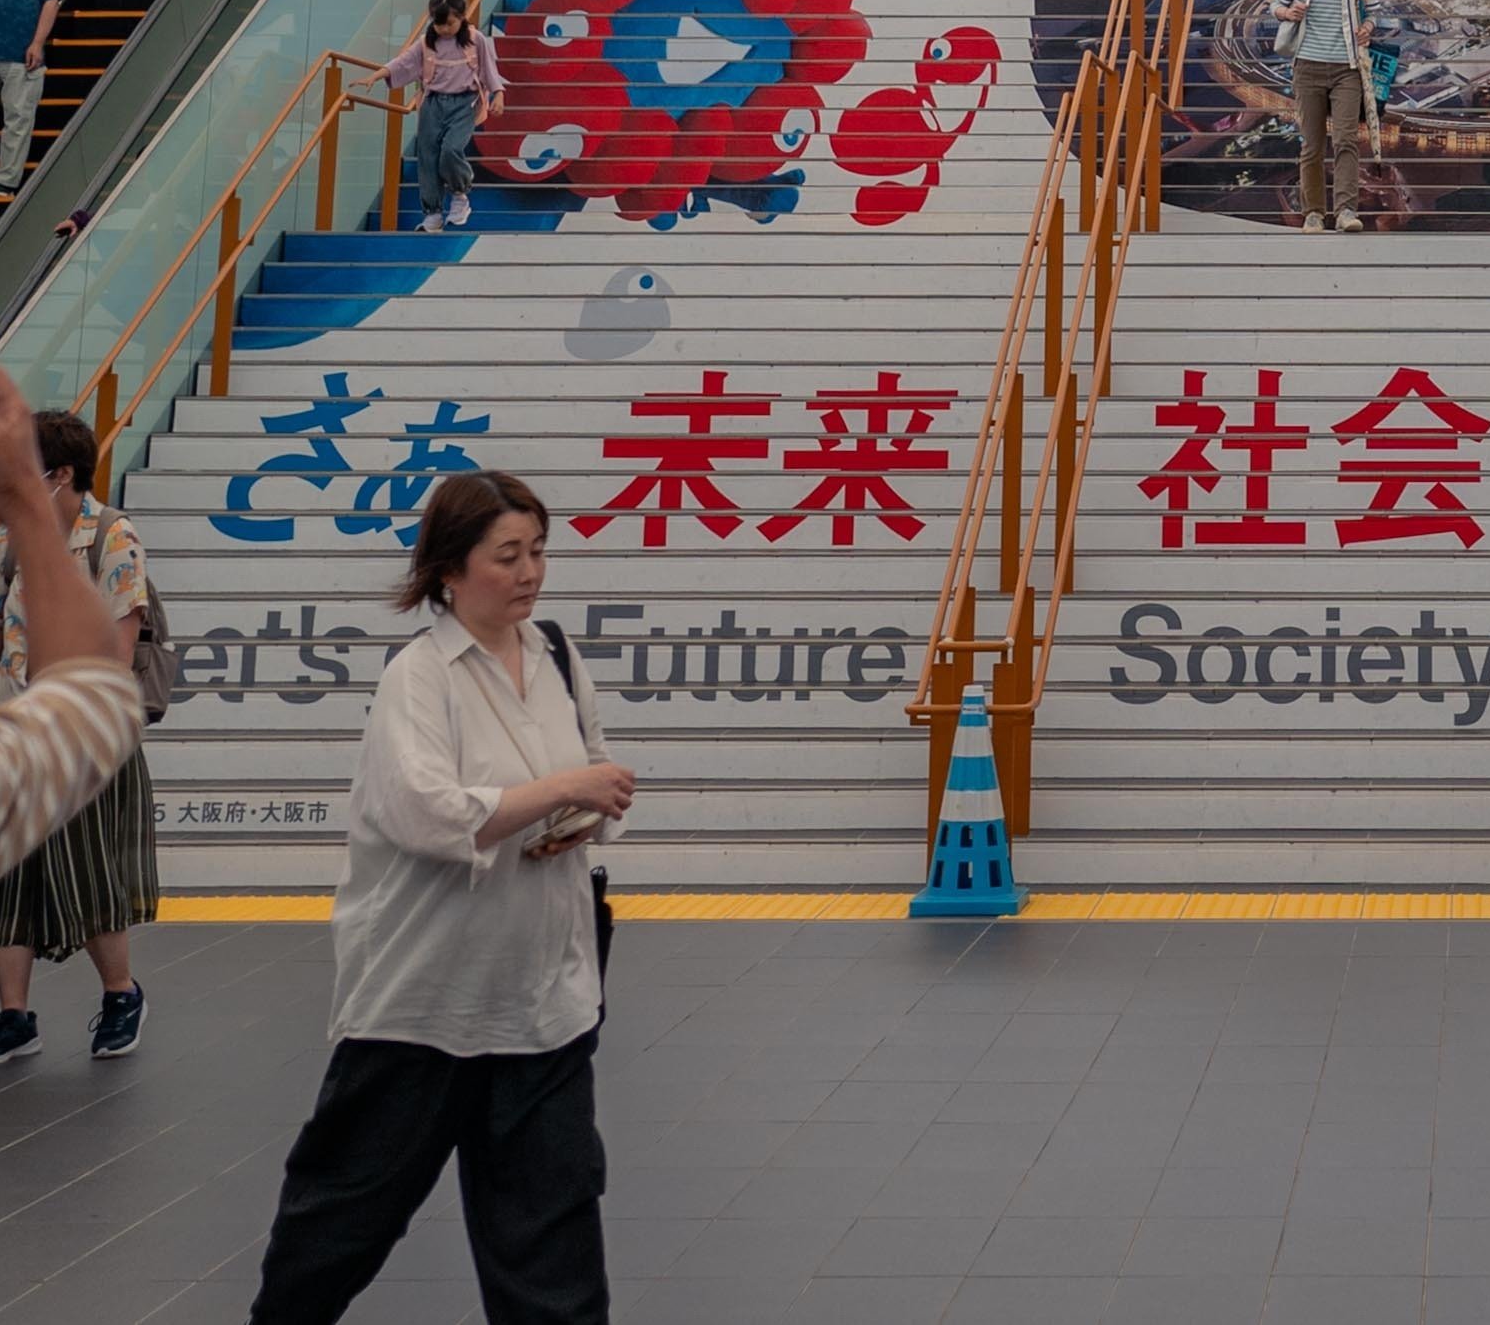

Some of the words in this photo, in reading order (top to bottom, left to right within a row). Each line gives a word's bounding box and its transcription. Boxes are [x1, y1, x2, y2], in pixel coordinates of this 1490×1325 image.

[207, 372, 491, 547] さあ
[568, 370, 959, 548] 未来
[166, 605, 369, 704] et's
[584, 603, 906, 702] Future
[178, 801, 330, 823] 大阪府・大阪市
